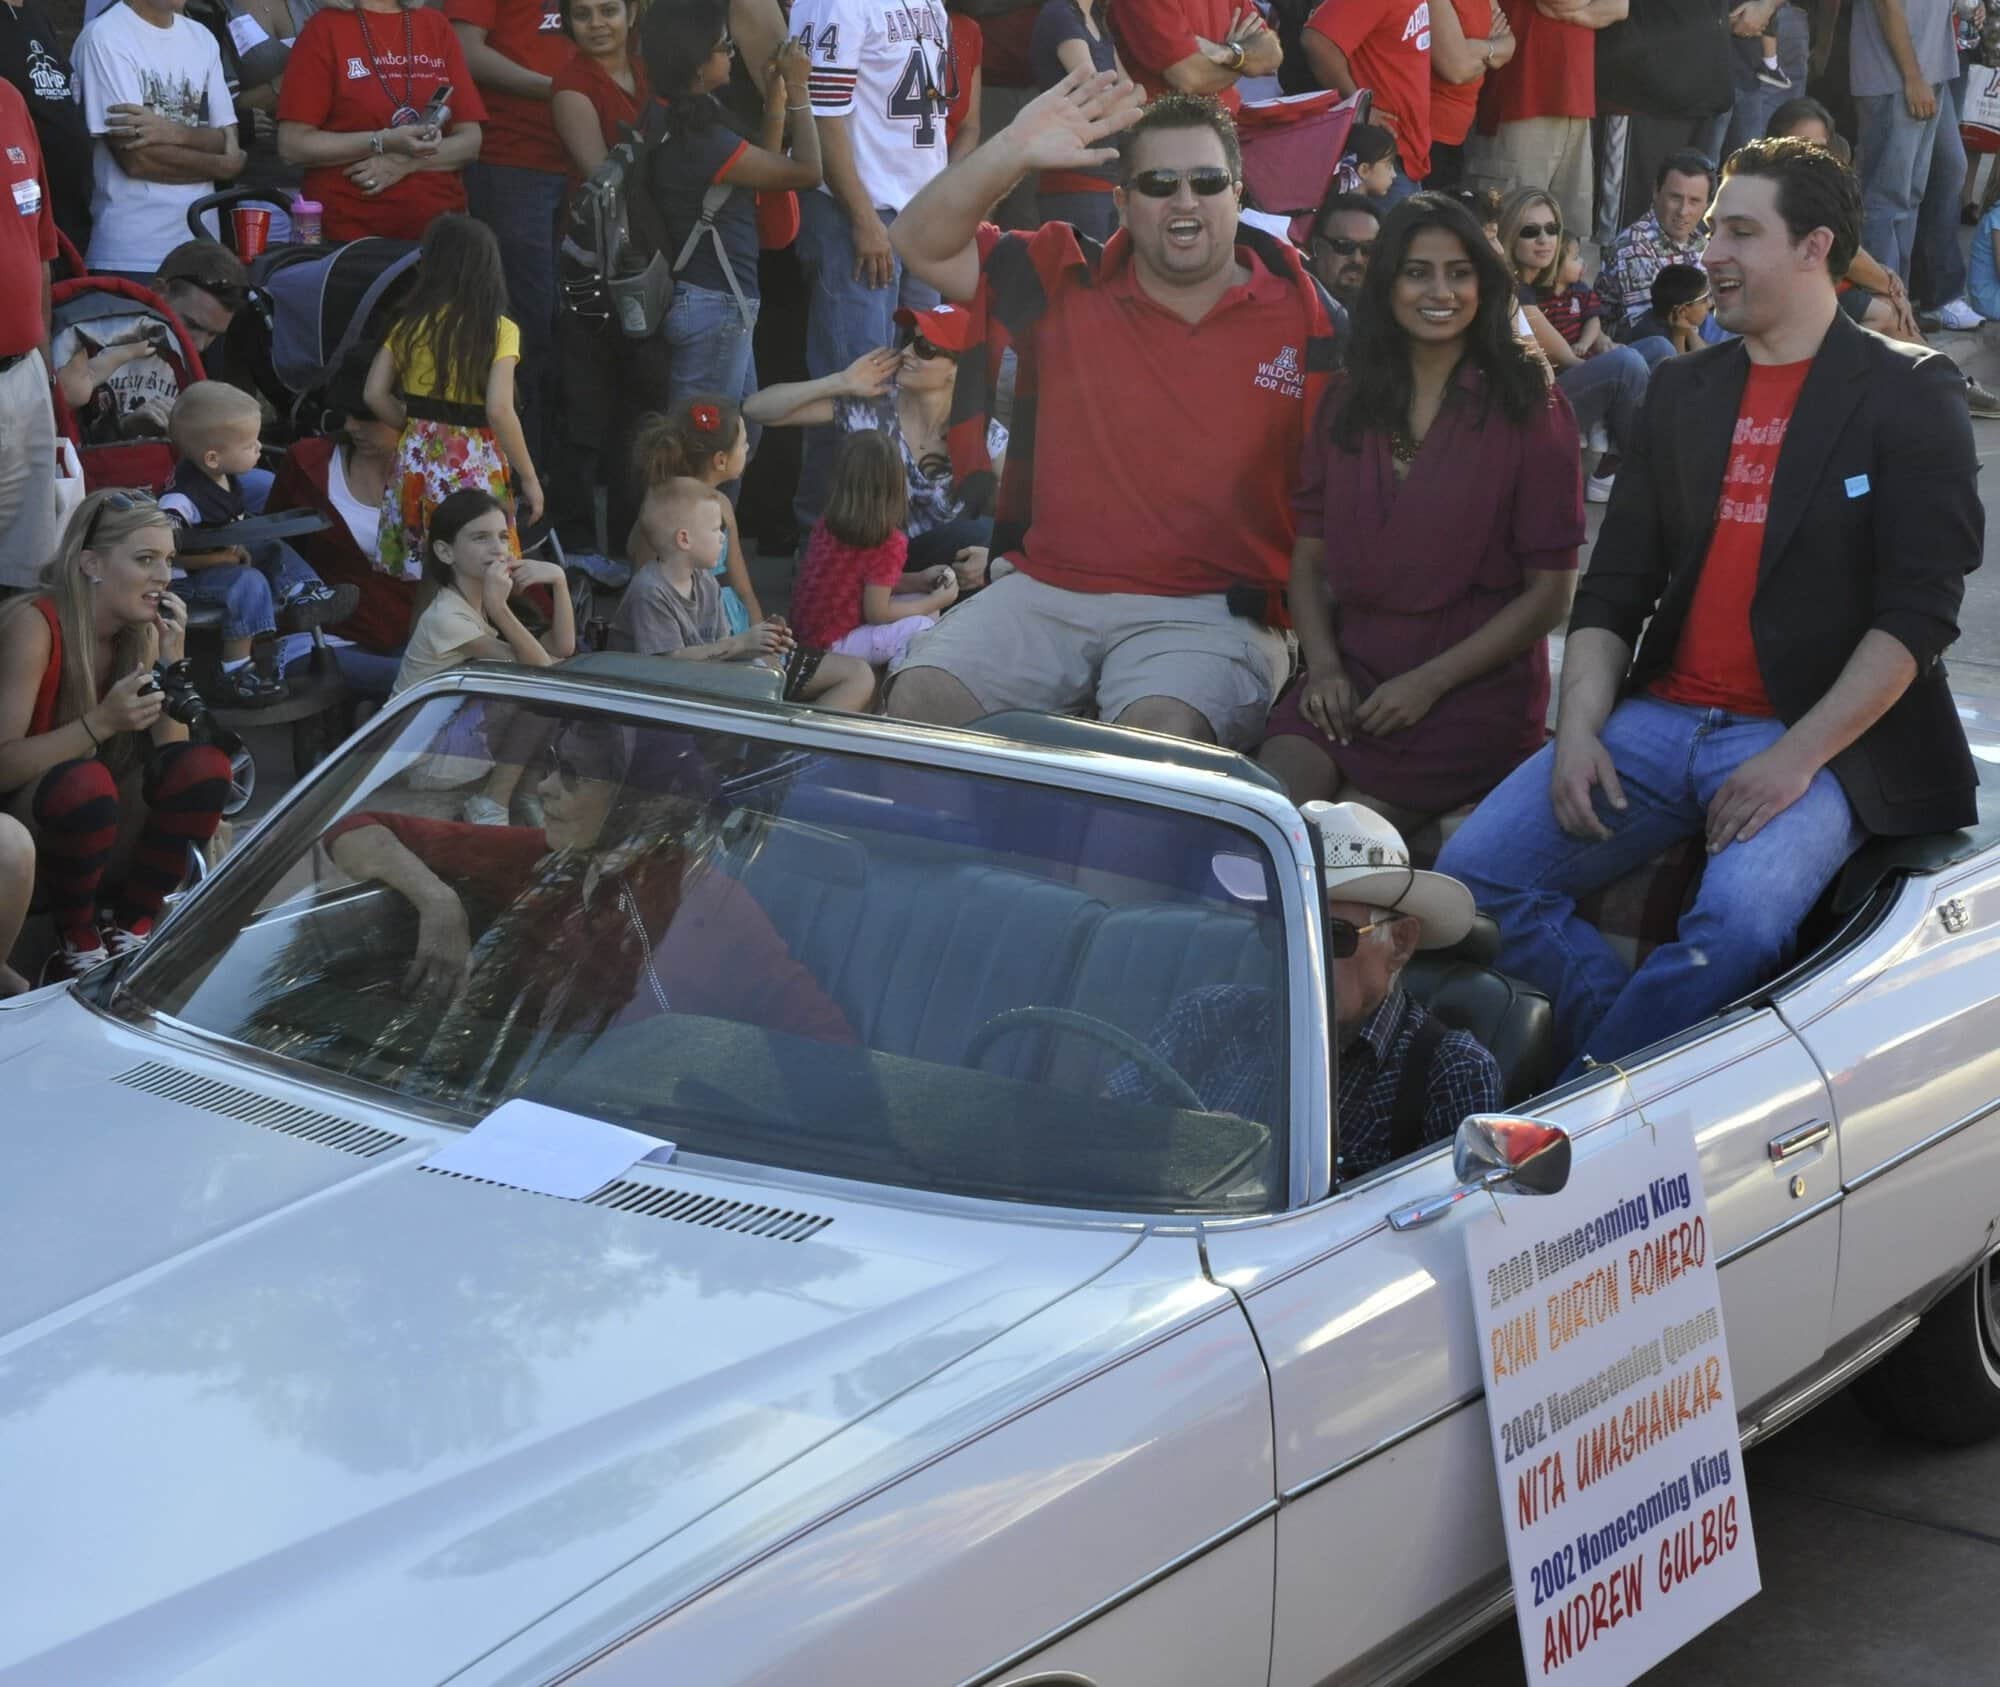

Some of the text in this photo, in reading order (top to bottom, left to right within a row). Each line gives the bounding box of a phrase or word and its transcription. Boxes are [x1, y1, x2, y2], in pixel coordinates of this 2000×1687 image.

[1254, 376, 1303, 399] FOR LIFE
[1487, 1171, 1692, 1310] 2000 Homecoming King
[1490, 1215, 1706, 1386] RYAN BURTON ROMERO
[1500, 1306, 1721, 1465] 2002 Homecoming Queen
[1517, 1356, 1723, 1531] NITA UMASHANKAR
[1530, 1448, 1732, 1608] 2002 Homecoming King
[1543, 1495, 1739, 1675] ANDREW GULBIS
